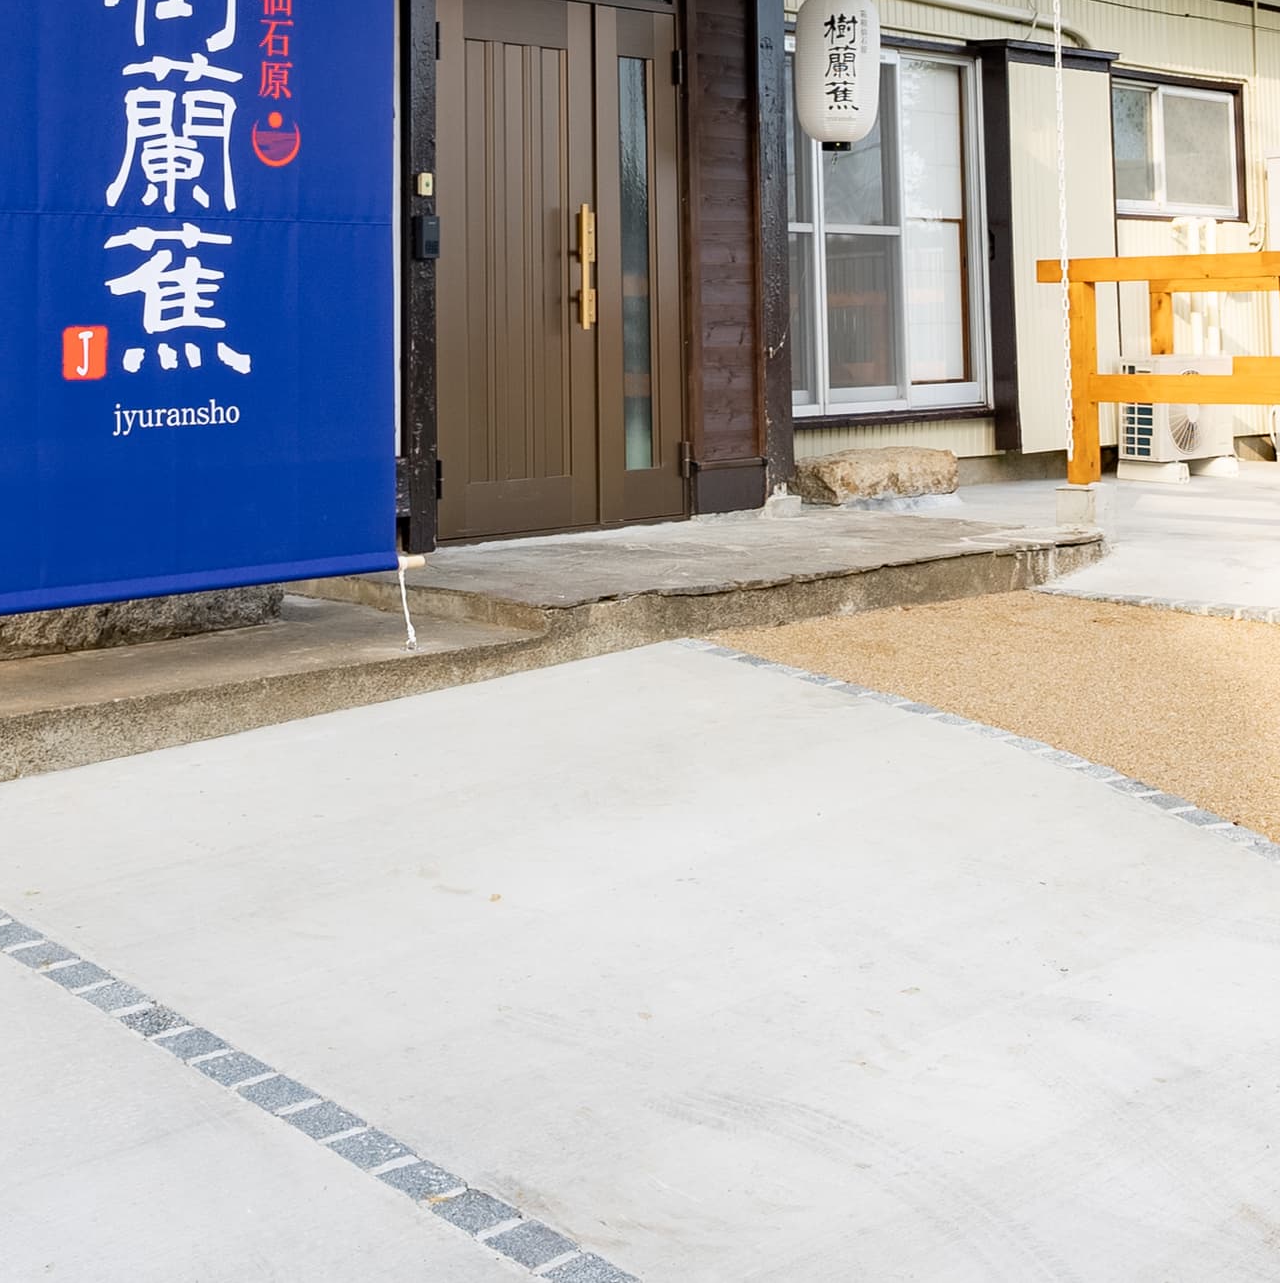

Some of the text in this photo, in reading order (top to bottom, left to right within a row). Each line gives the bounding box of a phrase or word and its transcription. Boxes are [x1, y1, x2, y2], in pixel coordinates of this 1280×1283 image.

[823, 13, 859, 110] 樹蘭蕉
[76, 331, 94, 376] J
[113, 399, 240, 436] jyuransho
